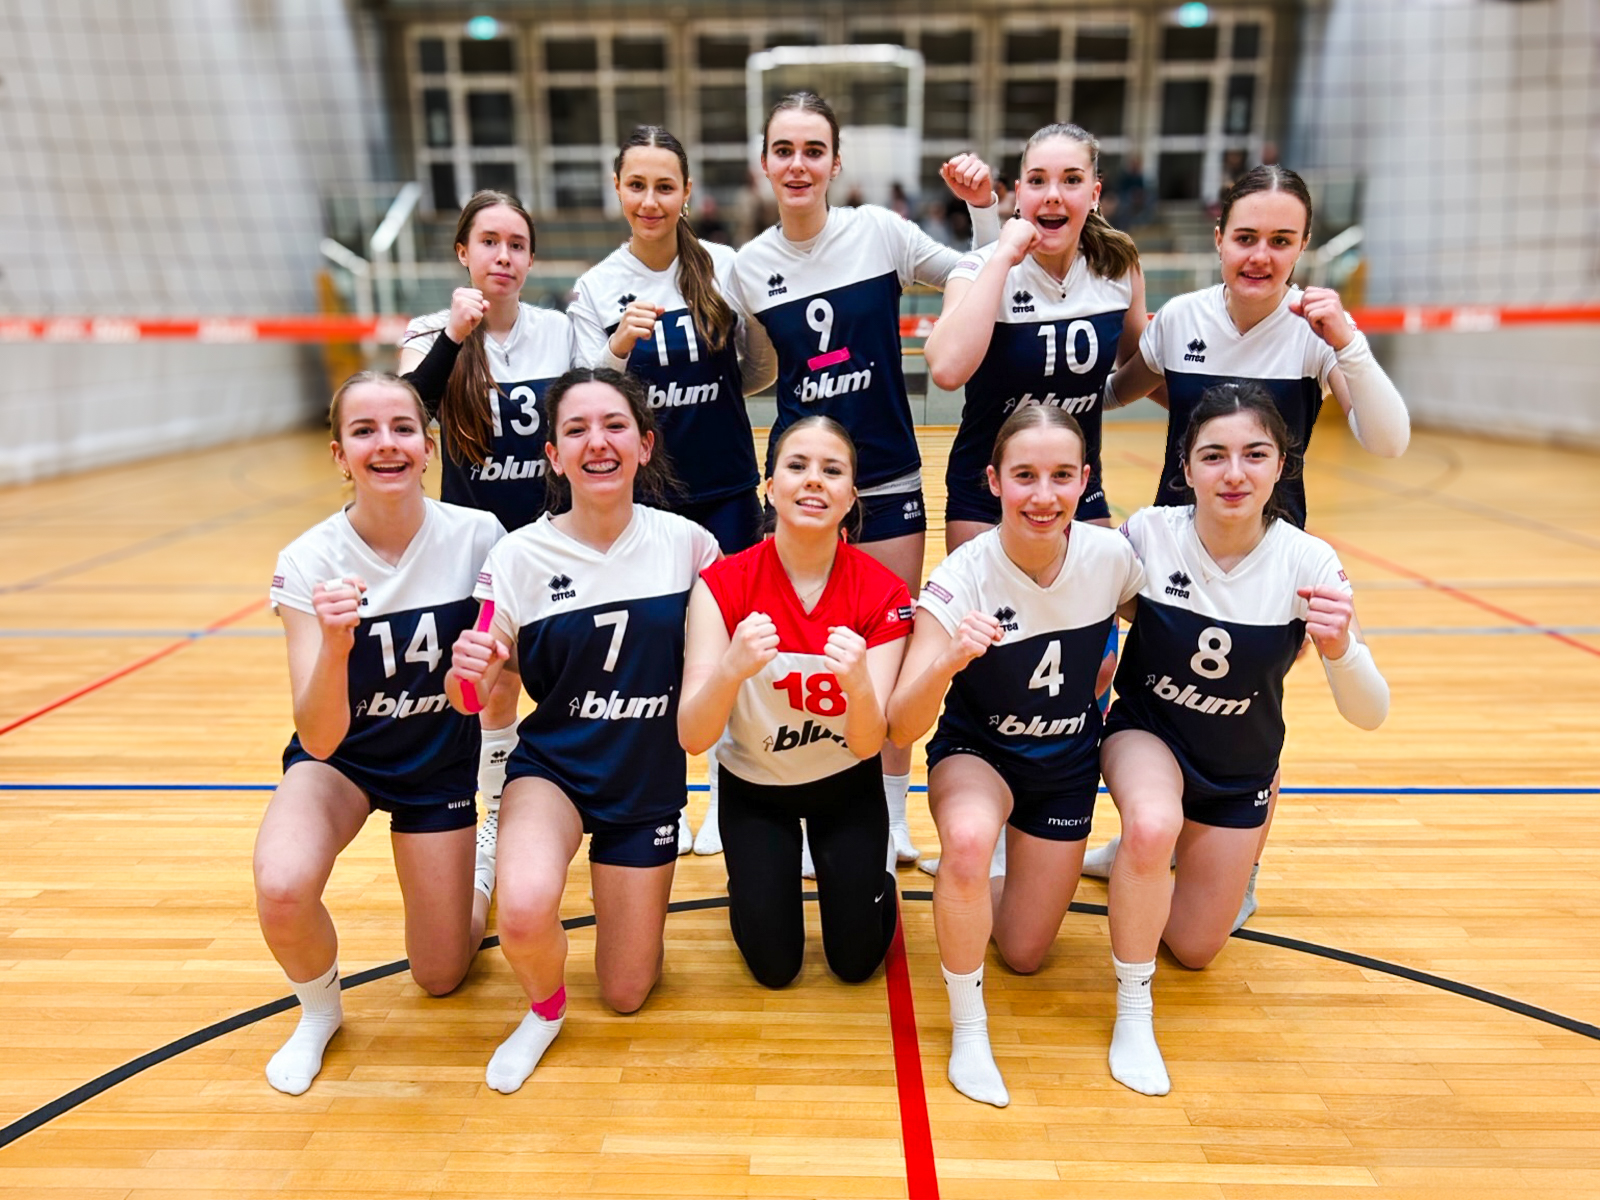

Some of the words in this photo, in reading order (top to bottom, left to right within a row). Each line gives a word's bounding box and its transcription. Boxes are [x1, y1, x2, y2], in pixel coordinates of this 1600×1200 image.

[806, 298, 834, 353] 9
[1012, 305, 1035, 314] errea
[654, 315, 699, 367] 11
[1037, 319, 1099, 377] 10
[1184, 352, 1205, 363] errea
[646, 382, 719, 409] blum
[801, 369, 871, 403] blum
[489, 385, 540, 437] 13
[551, 589, 576, 602] errea
[1165, 586, 1190, 600] errea
[368, 612, 443, 679] 14
[593, 609, 629, 673] 7
[1190, 626, 1232, 680] 8
[1028, 639, 1065, 697] 4
[579, 690, 669, 720] blum
[772, 671, 847, 717] 18
[1152, 675, 1251, 715] blum
[996, 712, 1087, 737] blum
